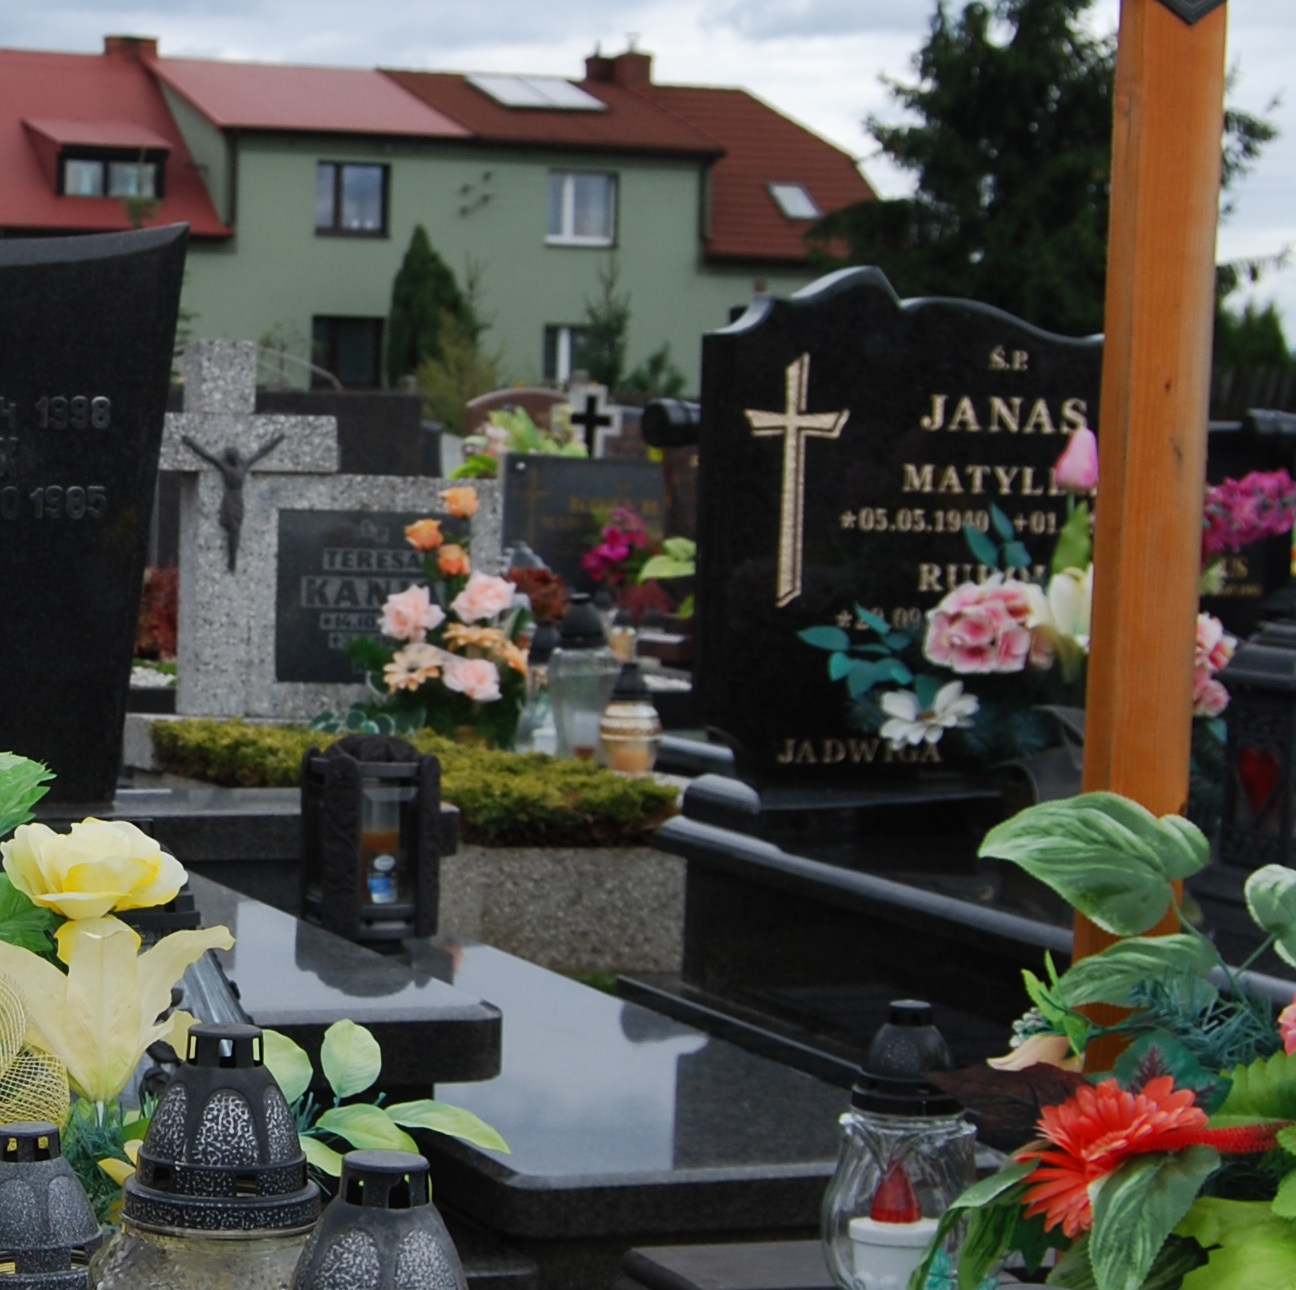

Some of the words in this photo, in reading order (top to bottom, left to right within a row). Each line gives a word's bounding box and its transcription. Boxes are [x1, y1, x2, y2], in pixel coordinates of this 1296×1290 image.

[35, 395, 112, 429] 1998
[919, 393, 1088, 434] JANAS
[29, 485, 108, 520] 1985
[326, 550, 422, 570] TERESA
[778, 738, 943, 763] JADWIGA
